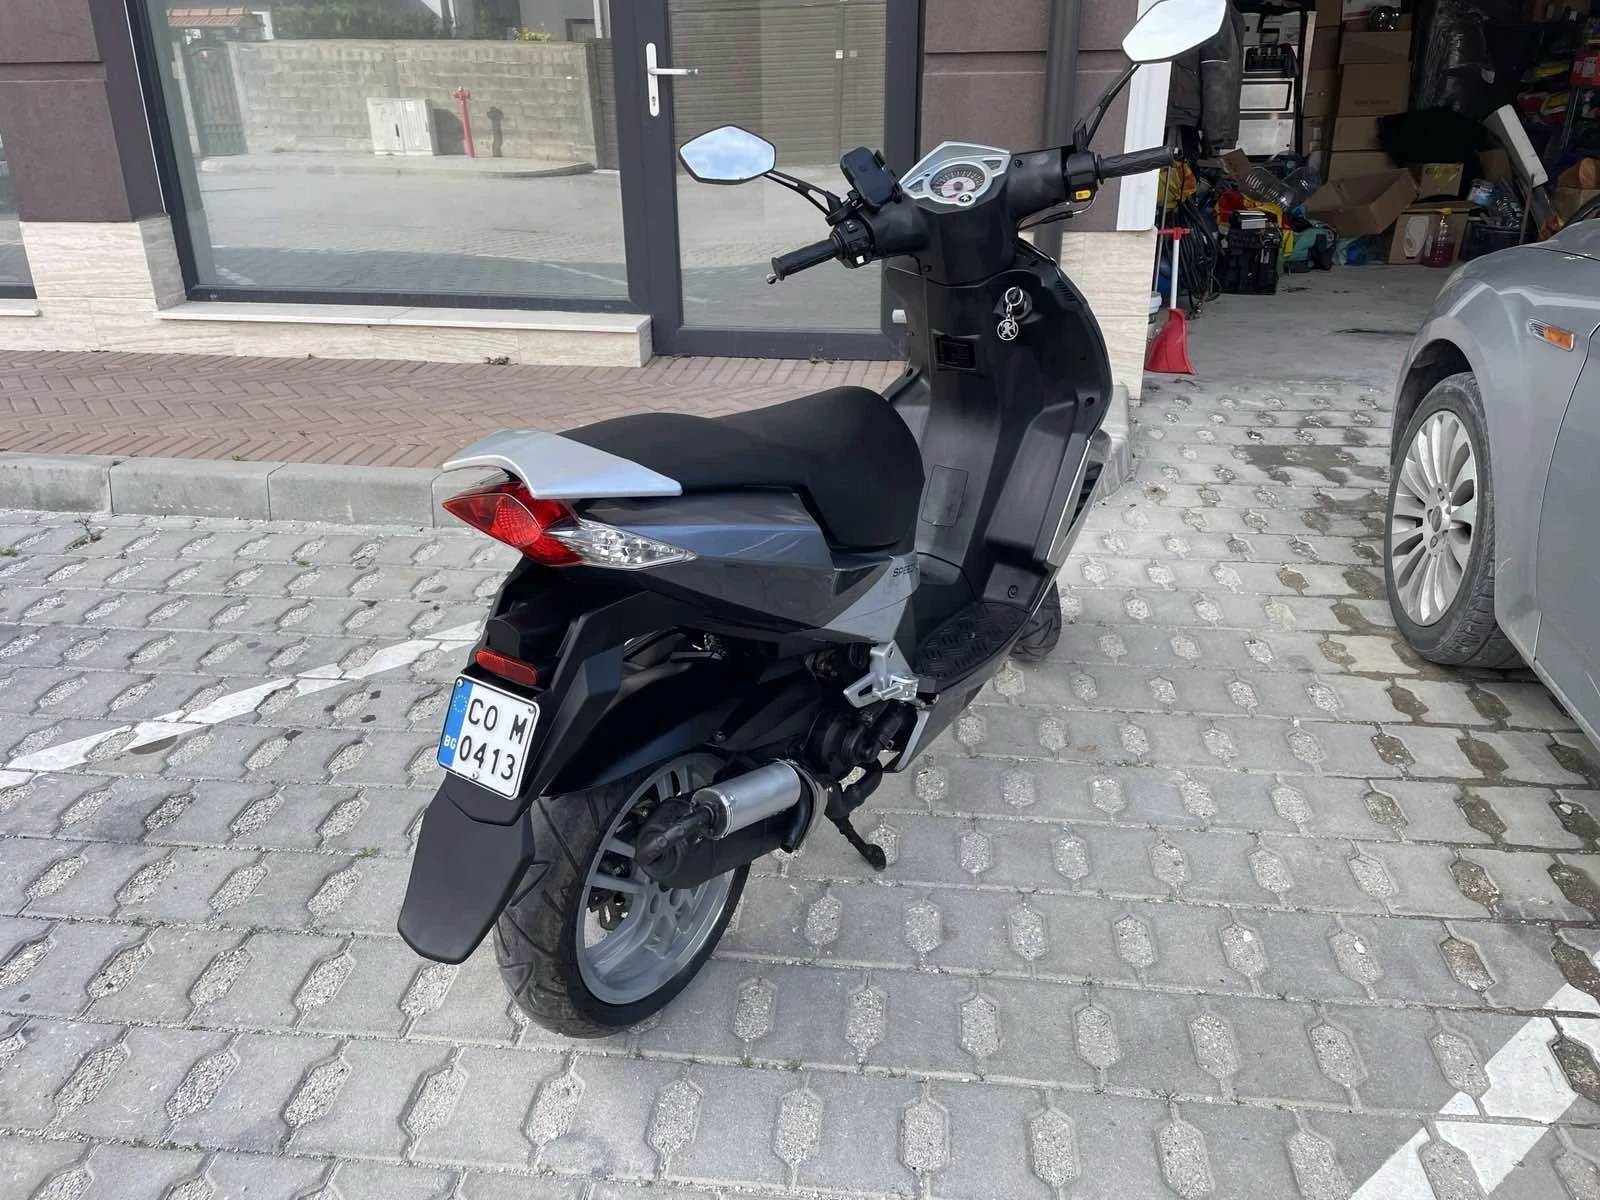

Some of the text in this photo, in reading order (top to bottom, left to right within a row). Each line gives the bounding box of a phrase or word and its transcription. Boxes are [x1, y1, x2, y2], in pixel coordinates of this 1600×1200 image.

[443, 734, 457, 750] BG
[468, 698, 528, 745] CO M
[459, 735, 516, 780] 0413
